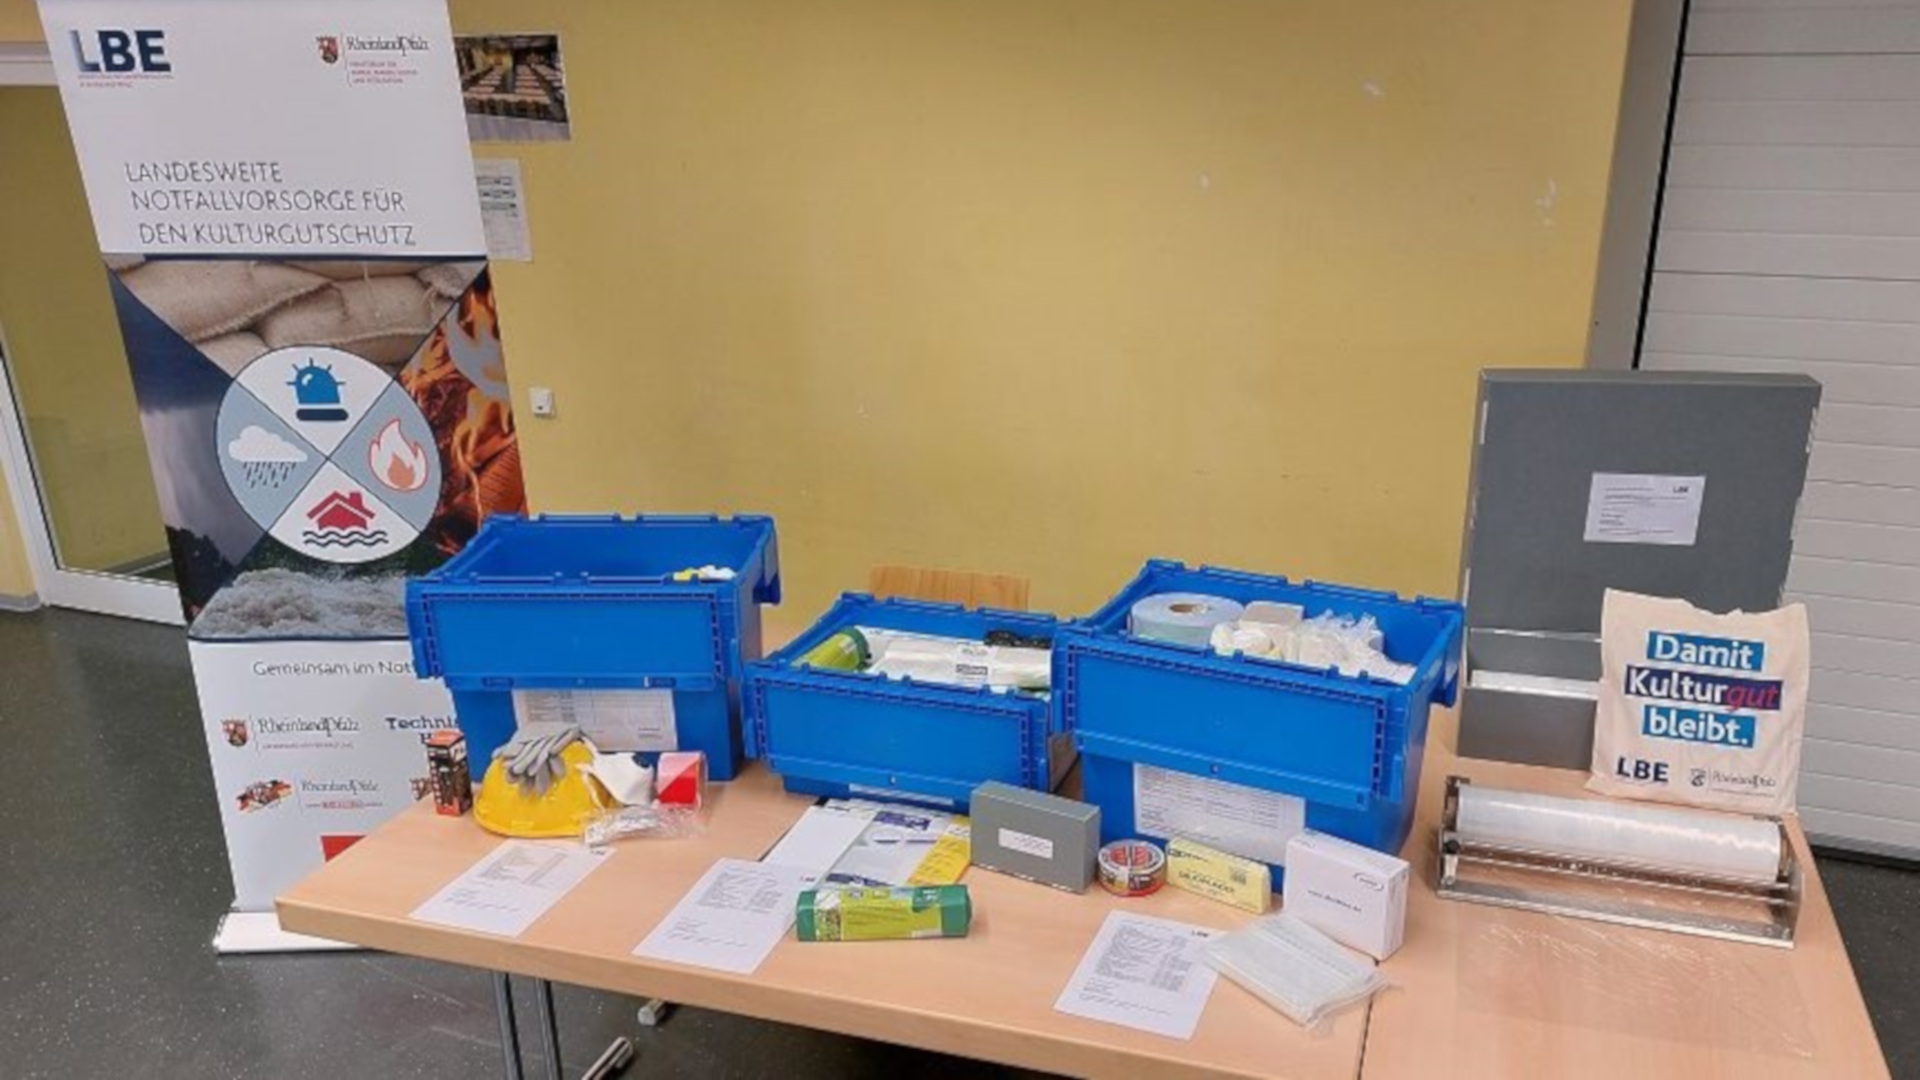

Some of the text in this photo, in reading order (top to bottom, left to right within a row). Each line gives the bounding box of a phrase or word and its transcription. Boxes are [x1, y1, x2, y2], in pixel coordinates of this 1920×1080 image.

[70, 30, 171, 72] LBE
[125, 161, 283, 183] LANDESWEITE
[131, 187, 406, 212] NOTFALLVORSORGE FÜR
[139, 223, 416, 246] DEN KULTURGUTSCHUTZ
[1654, 634, 1754, 669] Damit
[253, 661, 350, 676] Gemeinsam
[353, 661, 374, 674] im
[1629, 668, 1779, 713] Kulturgut
[1649, 706, 1749, 745] bleibt.
[1616, 756, 1670, 783] LBE
